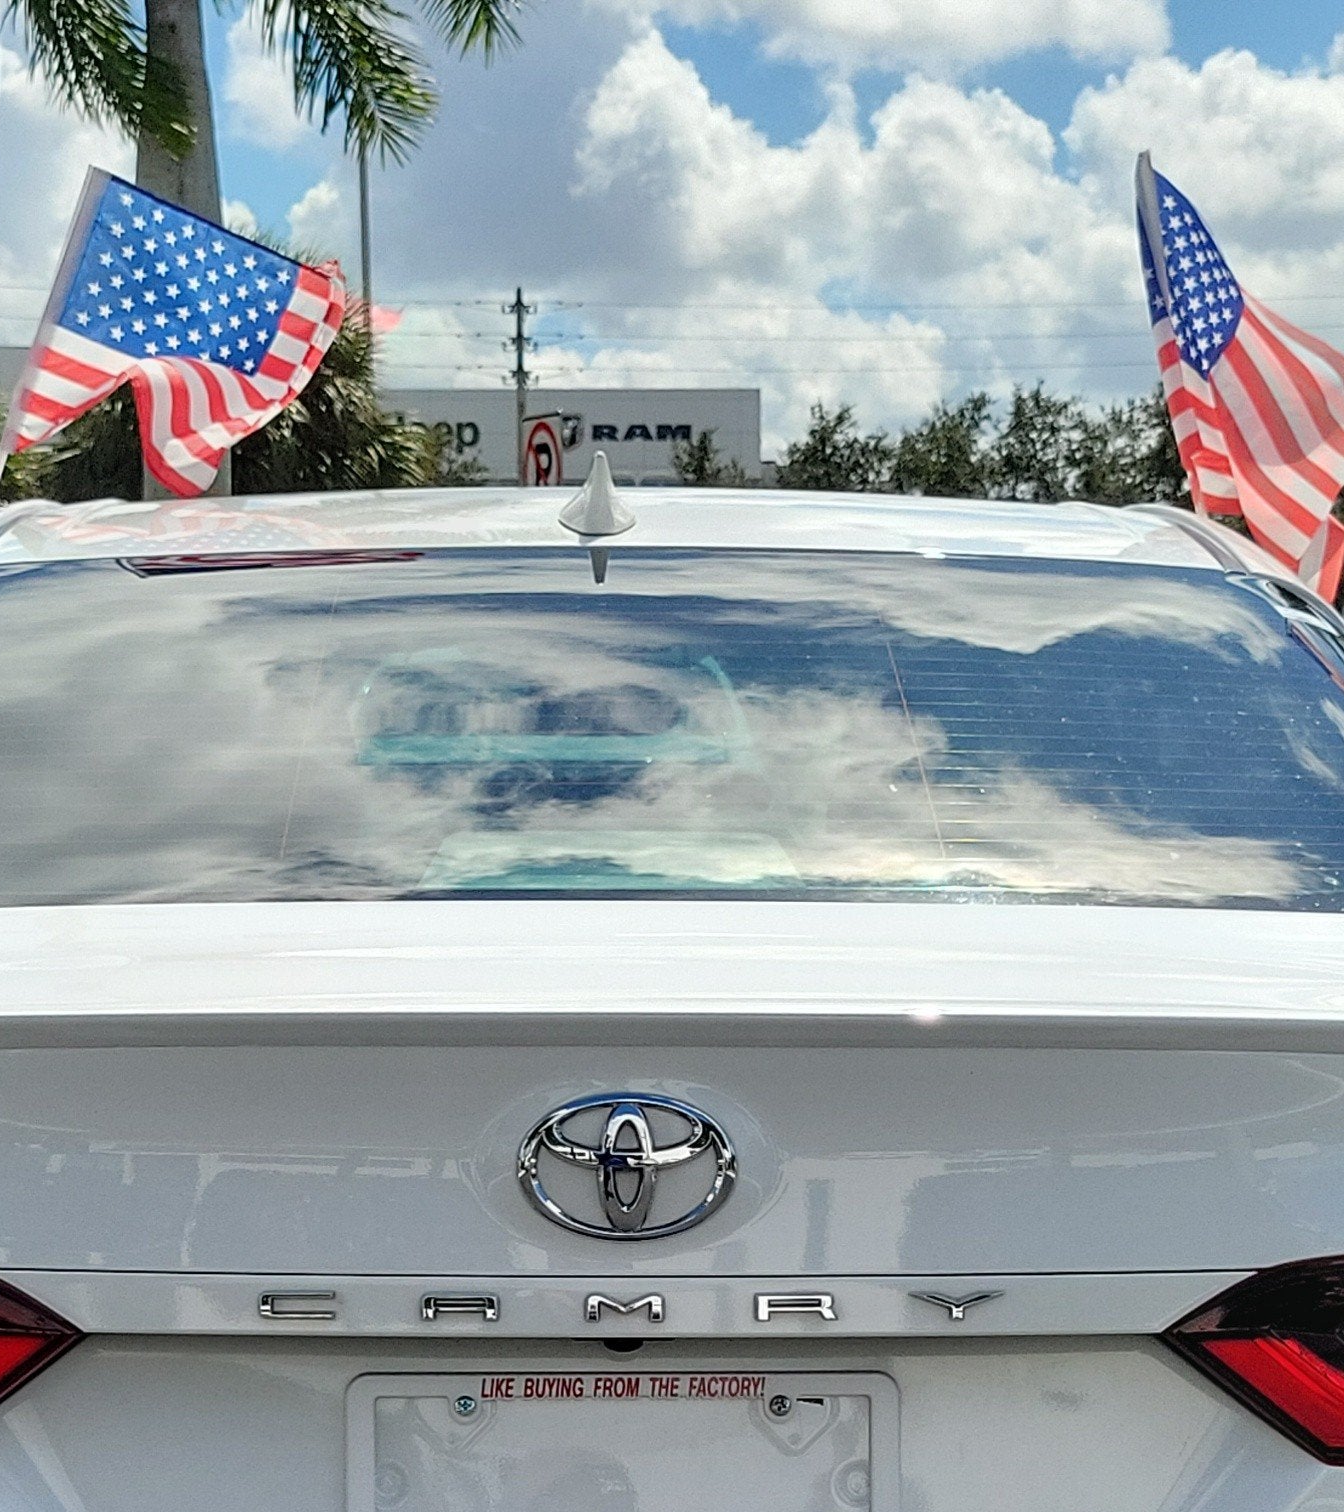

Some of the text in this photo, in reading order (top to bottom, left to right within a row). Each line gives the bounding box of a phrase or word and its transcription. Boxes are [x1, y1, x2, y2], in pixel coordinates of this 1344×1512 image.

[592, 424, 692, 441] RAM
[259, 1290, 1005, 1323] CAMRY
[481, 1376, 766, 1398] LIKE BUYING FROM THE FACTORY!
